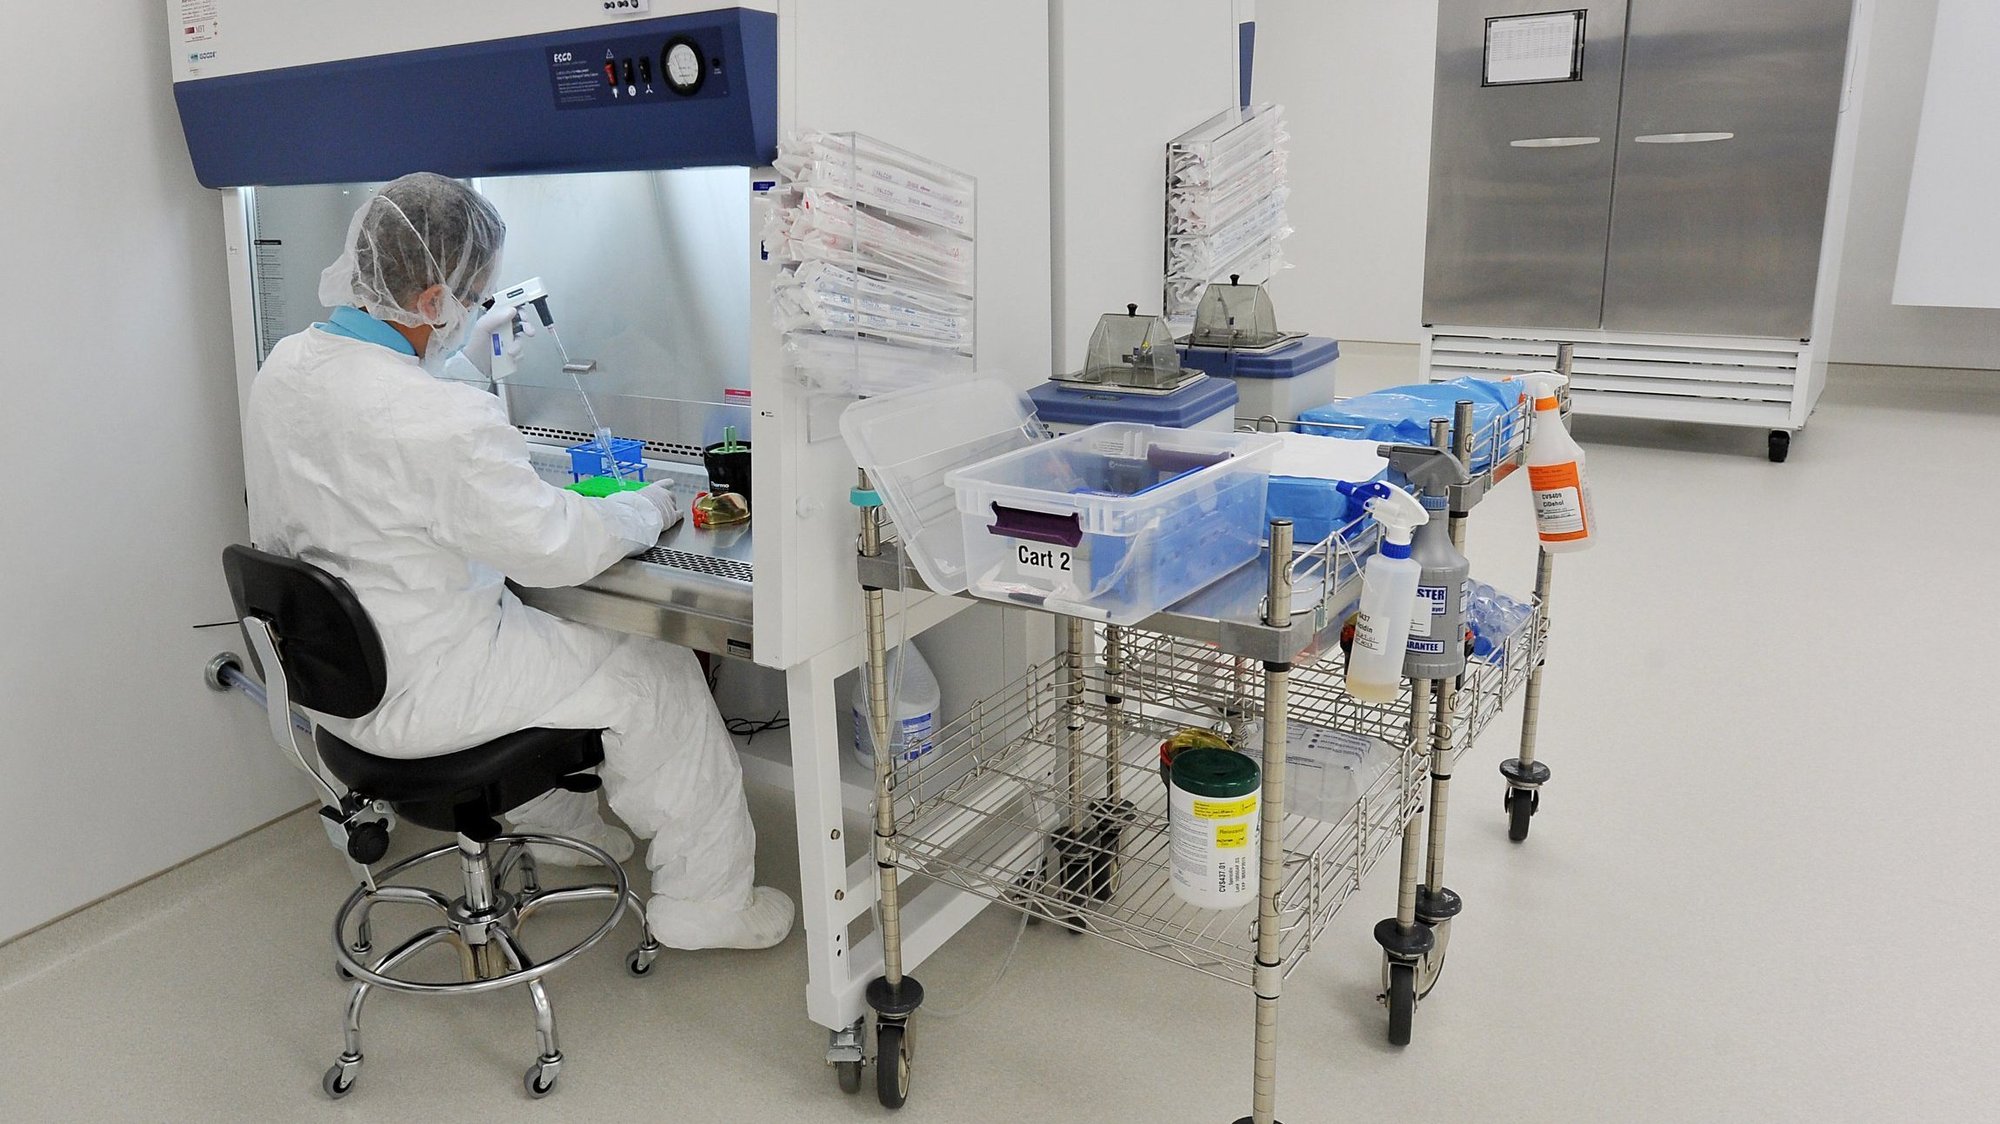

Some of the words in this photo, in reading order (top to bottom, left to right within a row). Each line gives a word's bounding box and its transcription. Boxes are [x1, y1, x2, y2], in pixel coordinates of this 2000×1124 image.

[1018, 545, 1053, 568] Cart
[1060, 552, 1070, 571] 2
[1416, 588, 1445, 600] STER
[1407, 640, 1439, 652] ARANTEE
